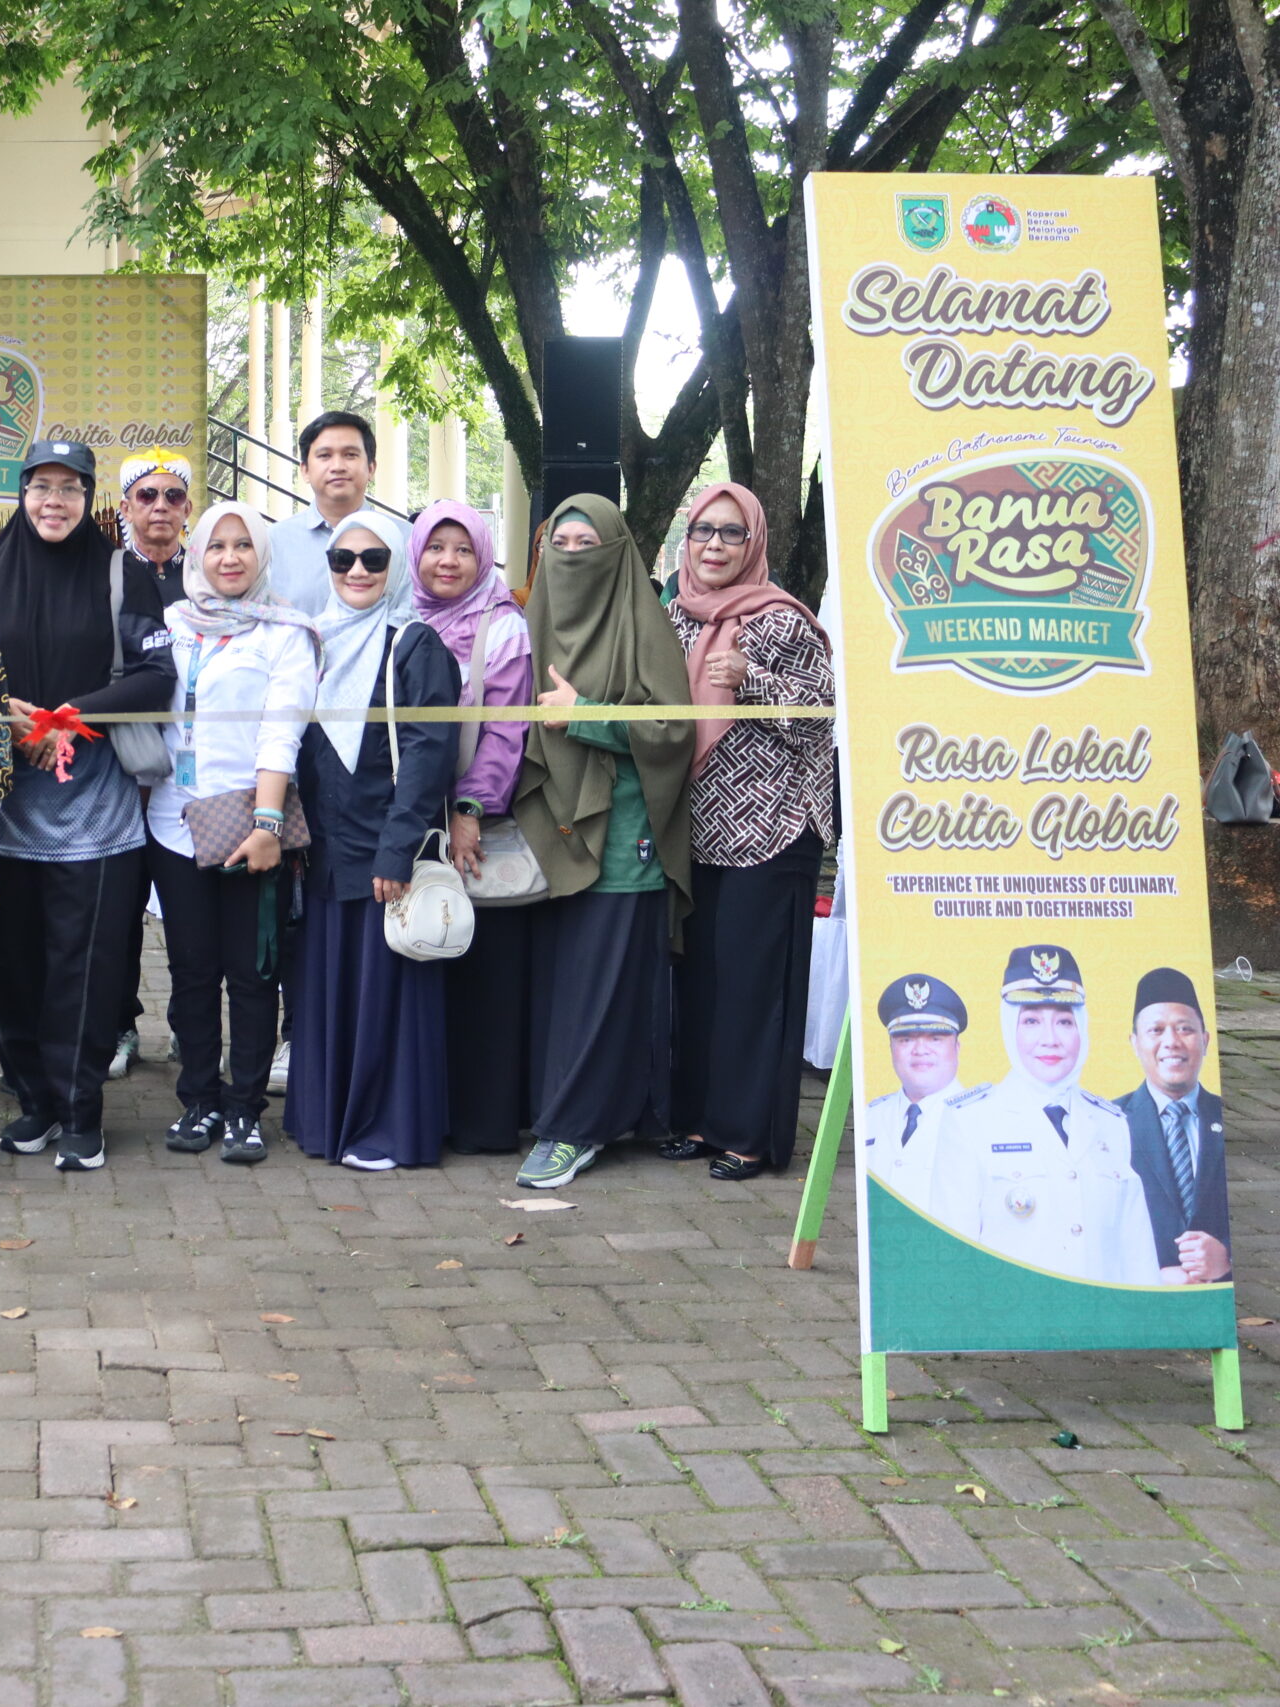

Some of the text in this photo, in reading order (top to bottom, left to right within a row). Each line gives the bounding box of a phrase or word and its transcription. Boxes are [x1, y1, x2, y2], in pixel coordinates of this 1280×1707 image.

[1026, 209, 1068, 218] Koperasi
[1028, 226, 1079, 234] Melangkah
[848, 268, 1104, 327] Selamat
[908, 342, 1145, 417] Datang
[119, 422, 194, 449] Global
[1055, 427, 1124, 452] Tourism
[922, 485, 1109, 538] Banua
[945, 528, 1090, 593] Rasa
[924, 617, 1112, 646] WEEKEND MARKET
[899, 725, 1150, 780] Rasa Lokal
[879, 792, 1178, 855] Cerita Global
[975, 876, 1001, 893] THE
[1003, 876, 1087, 894] UNIQUENESS
[1089, 876, 1106, 894] OF
[1108, 876, 1177, 895] CULINARY,
[933, 900, 1133, 918] CULTURE AND TOGETHERNESS!
